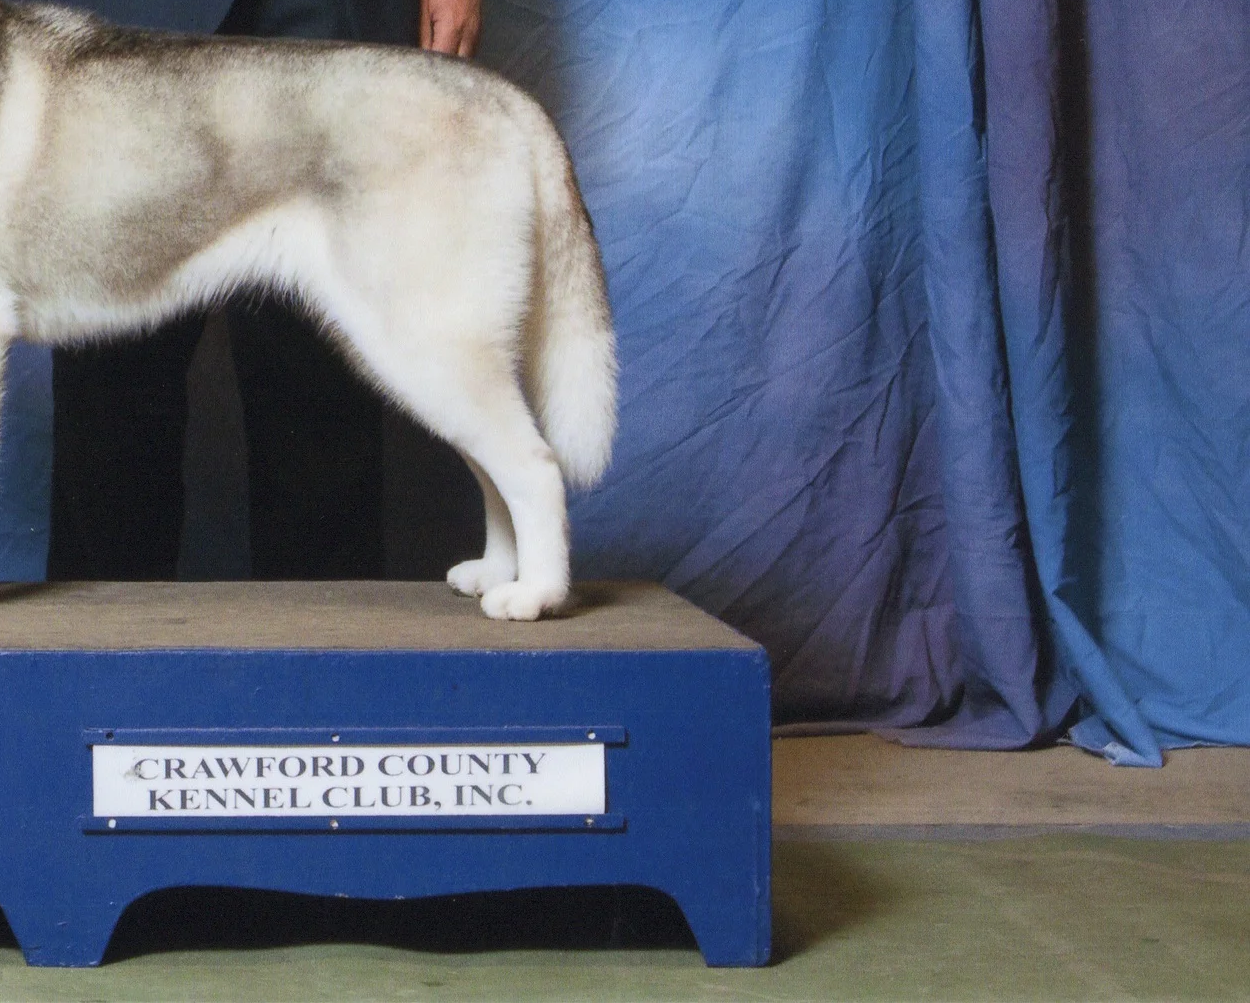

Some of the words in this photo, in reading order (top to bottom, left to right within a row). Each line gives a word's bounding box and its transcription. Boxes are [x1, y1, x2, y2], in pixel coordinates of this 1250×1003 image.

[134, 755, 365, 781] CRAWFORD
[378, 752, 547, 777] COUNTY
[148, 786, 312, 812] KENNEL
[321, 784, 441, 812] CLUB,
[455, 783, 533, 807] INC.
